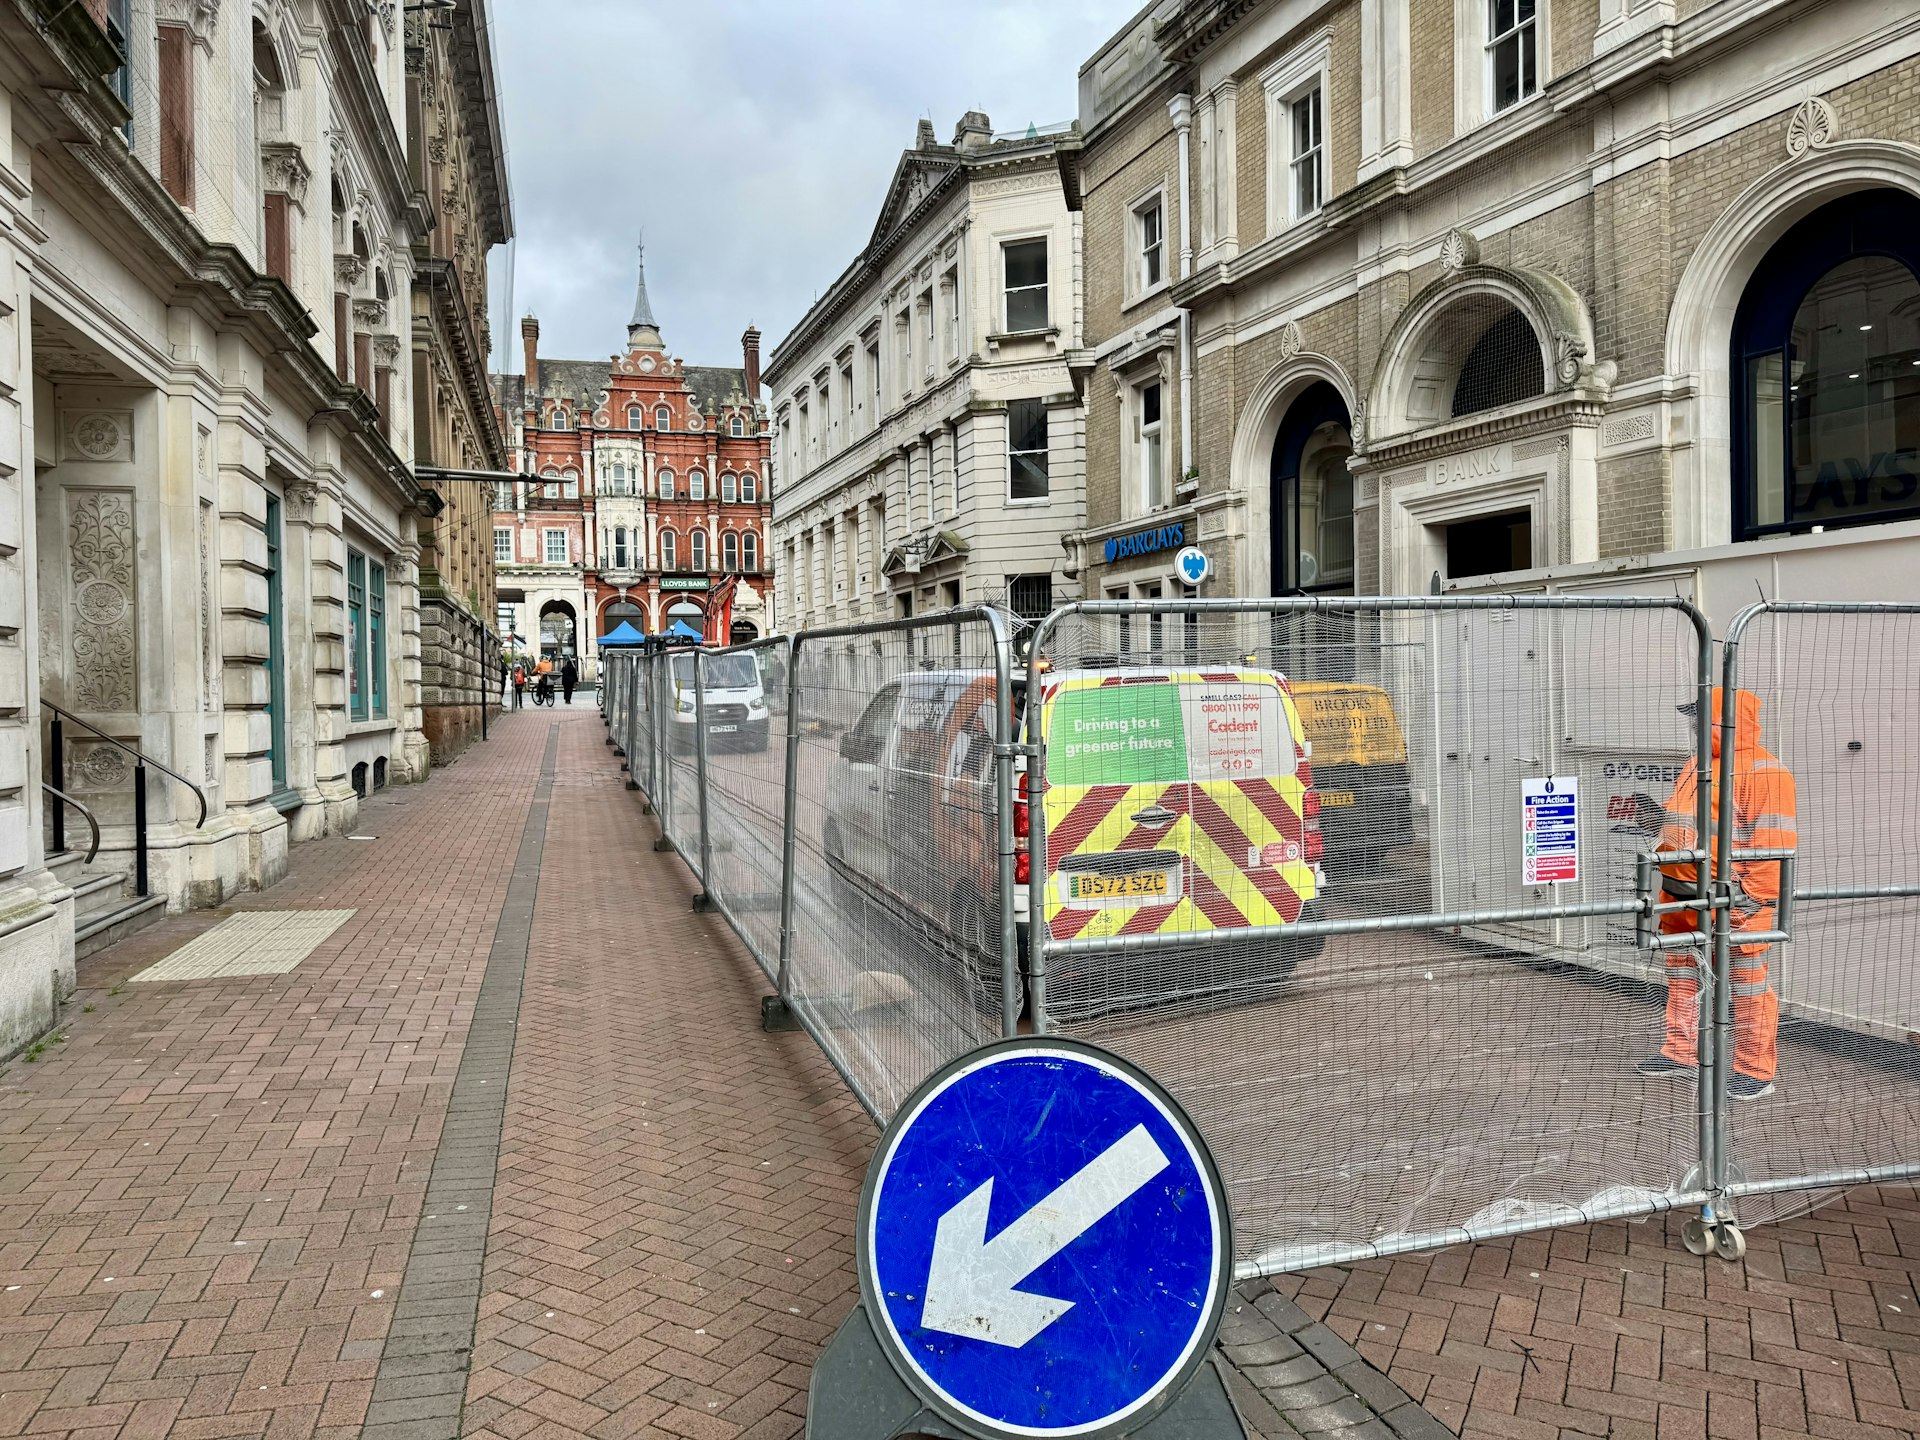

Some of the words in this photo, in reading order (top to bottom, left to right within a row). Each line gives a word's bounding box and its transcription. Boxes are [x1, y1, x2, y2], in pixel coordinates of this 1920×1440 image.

[1435, 447, 1501, 486] BANK
[1119, 523, 1185, 558] BARCLAYS
[1201, 704, 1226, 713] 0800
[1228, 703, 1241, 712] 111
[1243, 703, 1260, 712] 999
[1314, 698, 1372, 711] BROOKS
[1074, 717, 1129, 733] Driving
[1132, 717, 1147, 729] to
[1150, 718, 1160, 728] a
[1208, 717, 1259, 733] Cadent
[1315, 716, 1362, 729] WOOD
[1365, 717, 1389, 729] LTD
[1065, 741, 1126, 757] greener
[1128, 736, 1173, 750] future
[1531, 796, 1545, 805] Fire
[1546, 795, 1570, 804] Action
[1081, 876, 1127, 894] DS72
[1131, 874, 1164, 892] SZC
